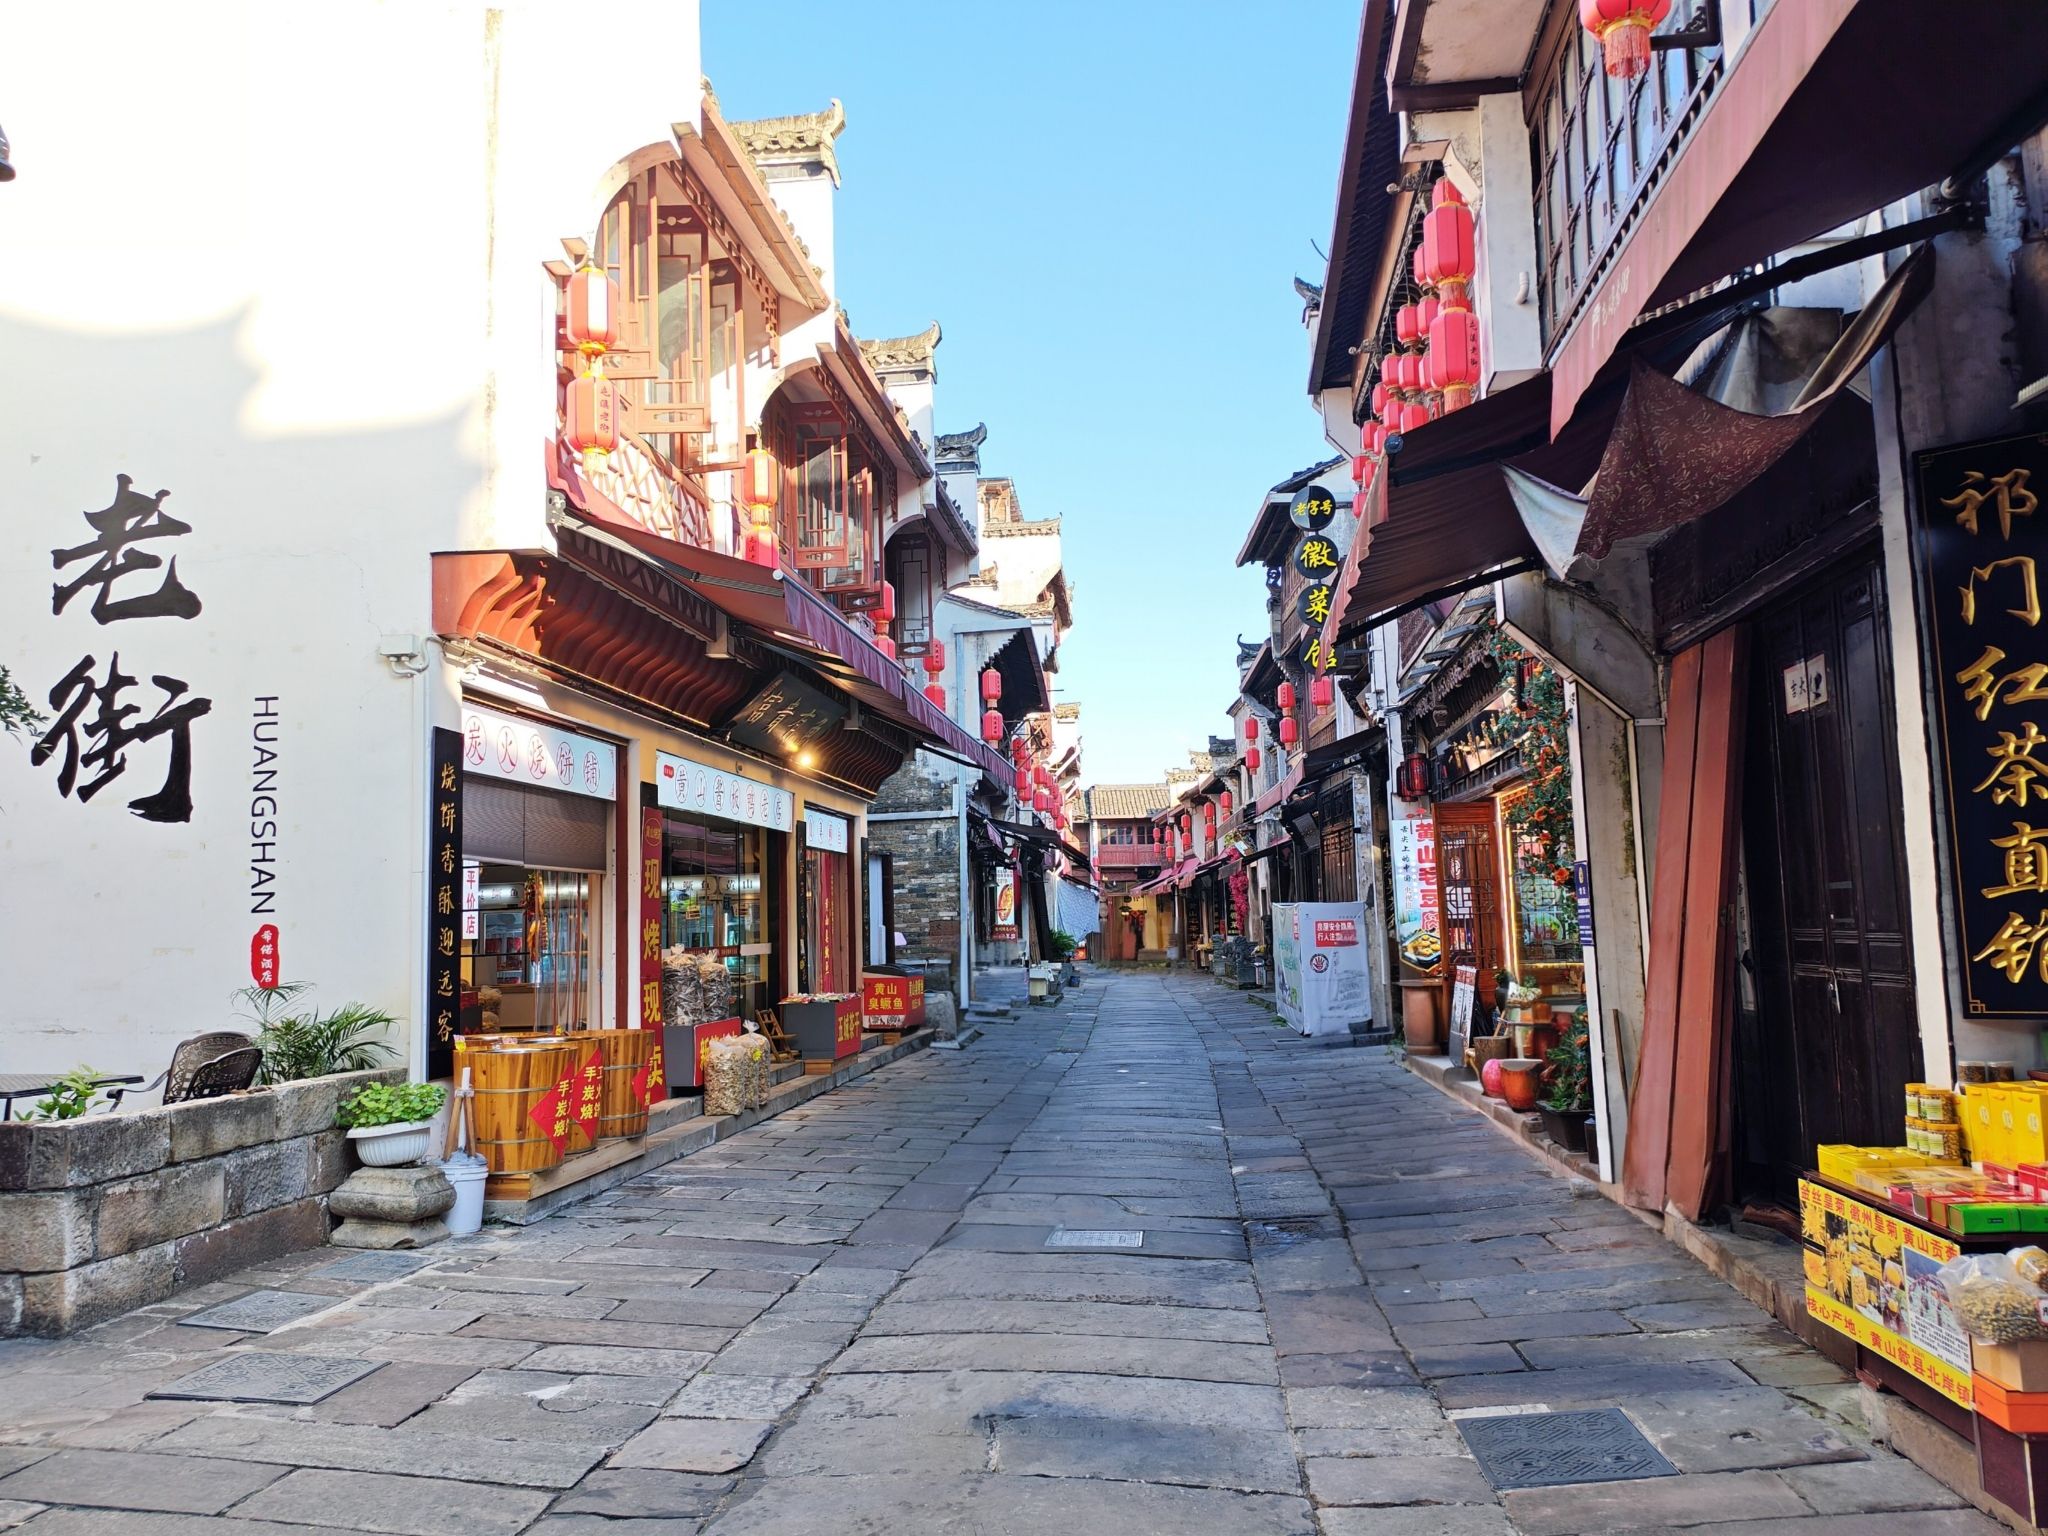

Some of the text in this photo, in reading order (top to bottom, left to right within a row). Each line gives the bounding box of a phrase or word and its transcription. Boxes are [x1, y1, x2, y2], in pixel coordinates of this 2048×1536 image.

[1293, 499, 1333, 516] 老字号
[31, 473, 212, 823] 老街
[465, 720, 600, 787] 炭火烧饼铺
[250, 695, 279, 914] HUANGSHAN
[1400, 825, 1412, 882] 舌尖上的中国
[466, 870, 476, 940] 平价店
[643, 858, 663, 1089] 现烤现卖
[874, 982, 897, 995] 黄山
[837, 1010, 860, 1042] 五城茶干
[1800, 1183, 1958, 1264] 金丝皇菊 徽州皇菊 黄山贡菊
[1870, 1330, 1970, 1403] 黄山歙县北岸镇
